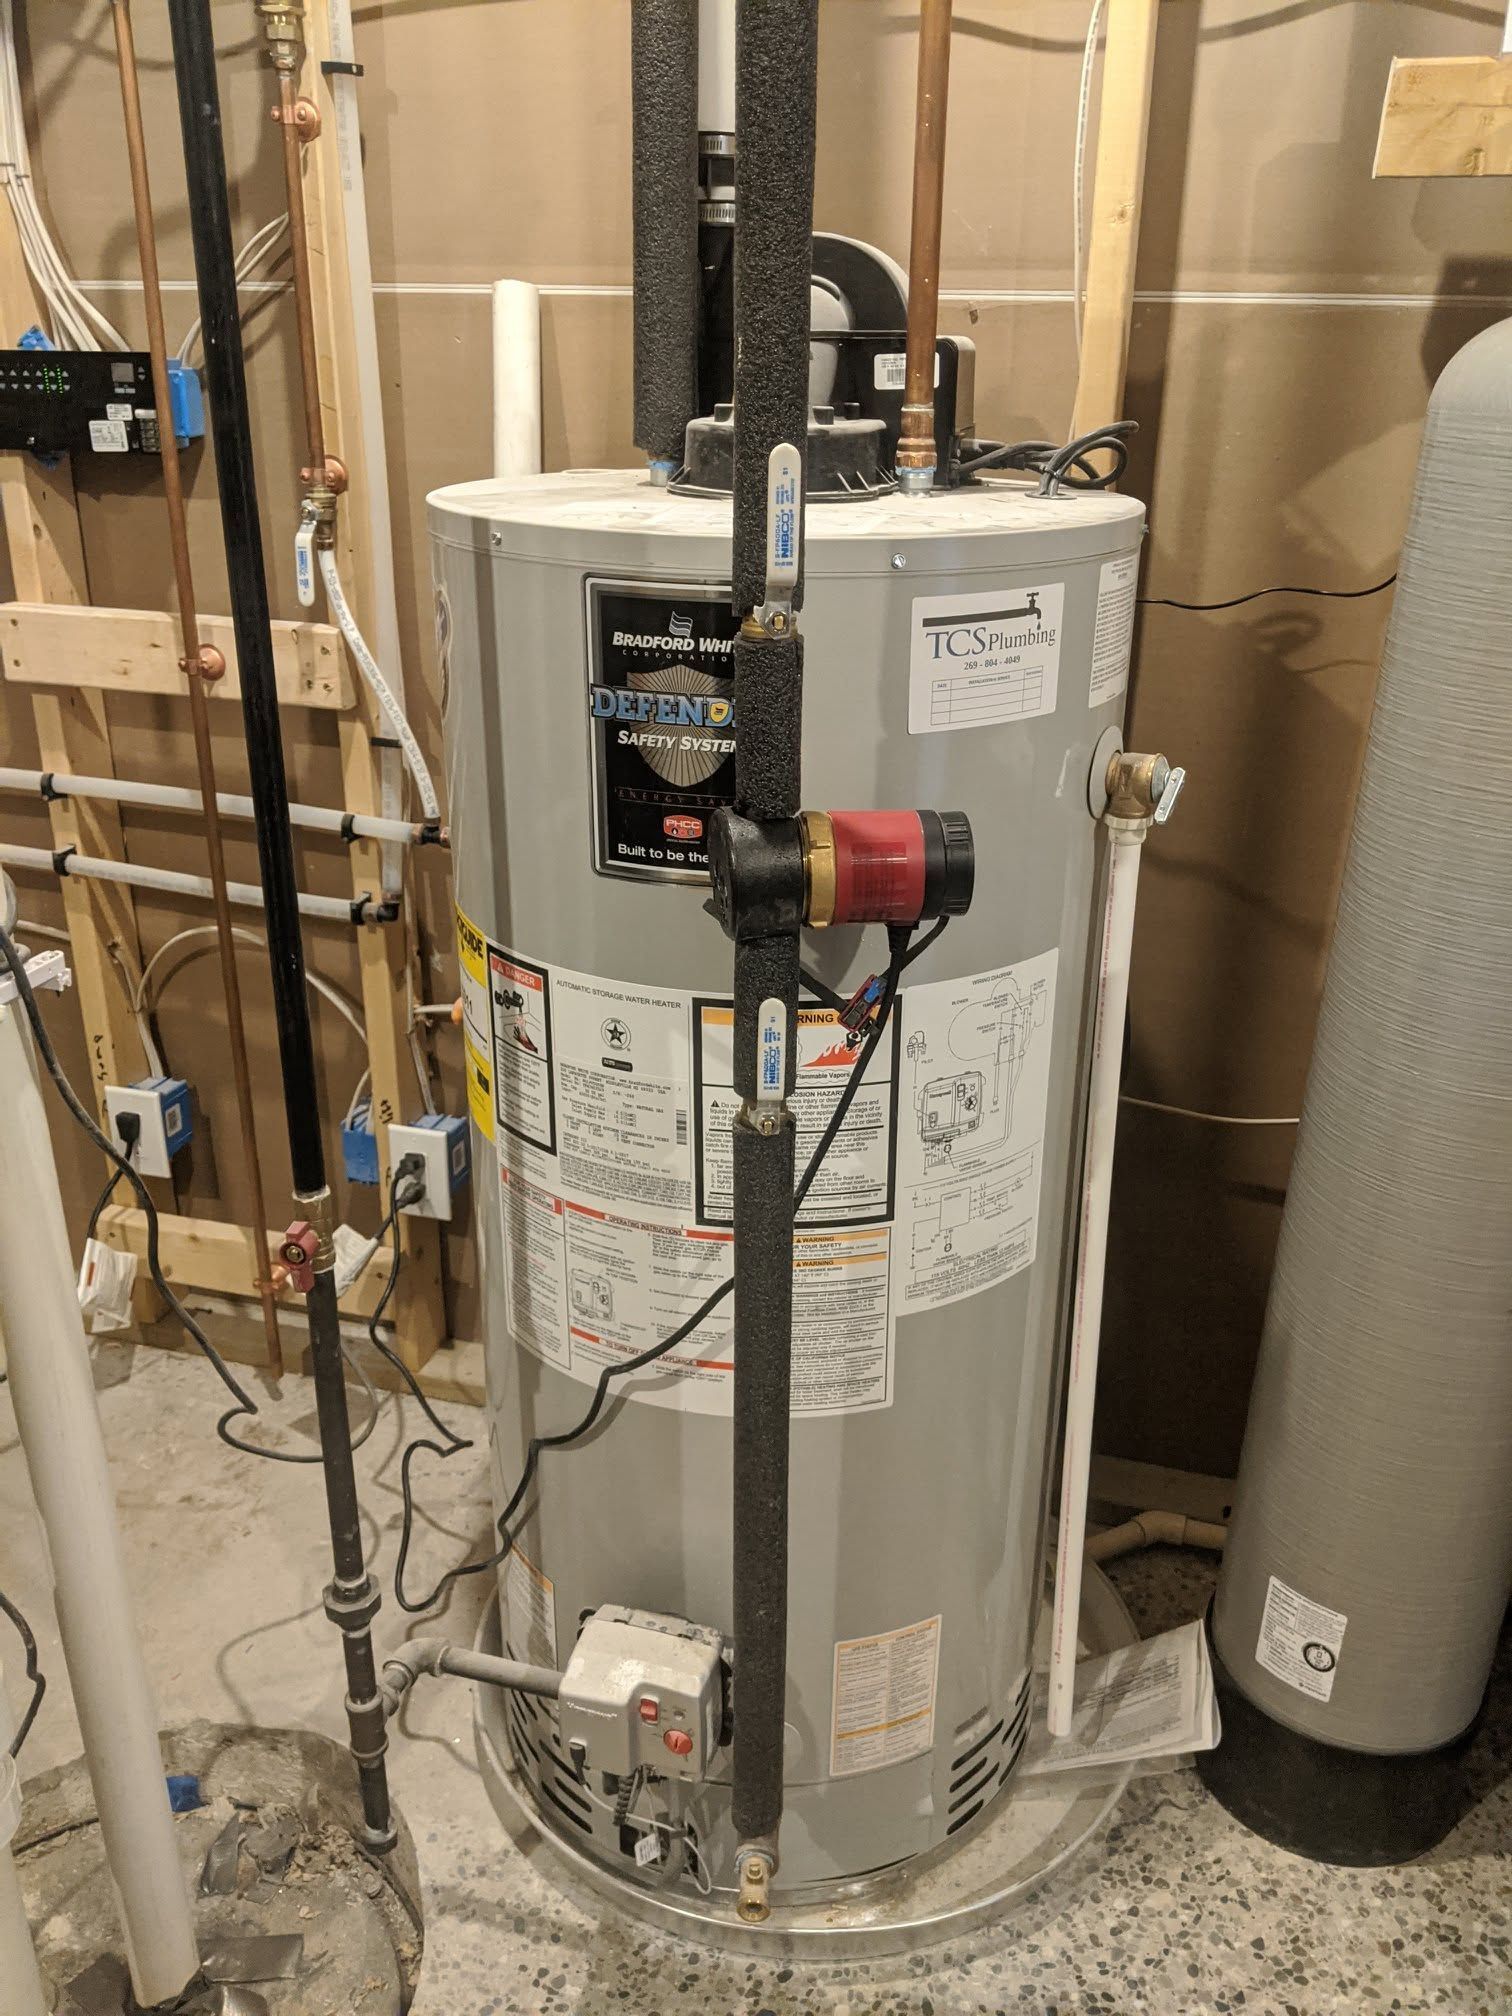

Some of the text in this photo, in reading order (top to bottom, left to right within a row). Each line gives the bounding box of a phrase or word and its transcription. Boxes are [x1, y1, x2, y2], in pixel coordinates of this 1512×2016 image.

[781, 513, 790, 558] NIBCO
[612, 631, 695, 651] BRADFORD
[926, 627, 1056, 659] TCS Plumbing
[622, 649, 727, 662] CORPORATIO
[964, 662, 978, 670] 269
[984, 659, 998, 668] 804
[591, 684, 736, 728] DEFEND
[617, 730, 677, 749] SAFETY
[666, 820, 700, 828] PHCC
[618, 844, 709, 863] Built to be the
[506, 964, 536, 987] DANGER
[972, 970, 1013, 986] WIRING DIAGRAM
[556, 980, 681, 1008] AUTOMATIC STORAGE WATER HEATER
[797, 1014, 834, 1024] RNING
